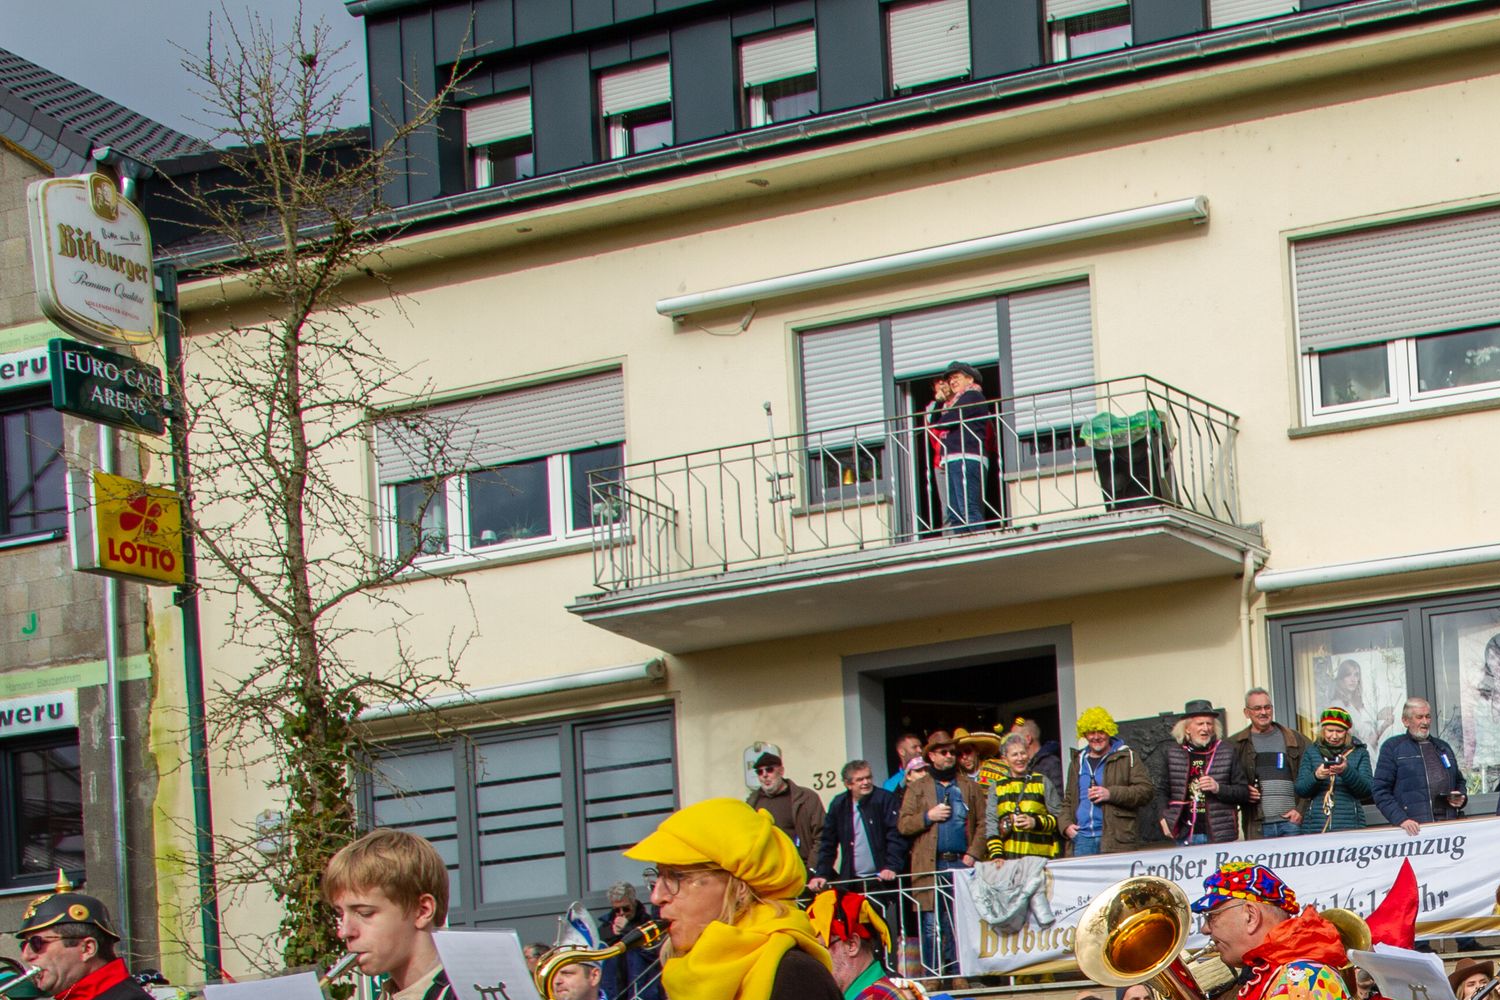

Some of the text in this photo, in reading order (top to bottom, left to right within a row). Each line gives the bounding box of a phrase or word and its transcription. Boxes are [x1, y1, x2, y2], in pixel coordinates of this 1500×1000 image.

[57, 222, 149, 284] Bitburger
[70, 270, 111, 294] Premium
[65, 351, 120, 382] EURO
[91, 385, 148, 416] ARENS
[108, 537, 176, 572] LOTTO
[813, 770, 837, 791] 32
[1129, 855, 1208, 883] Großer
